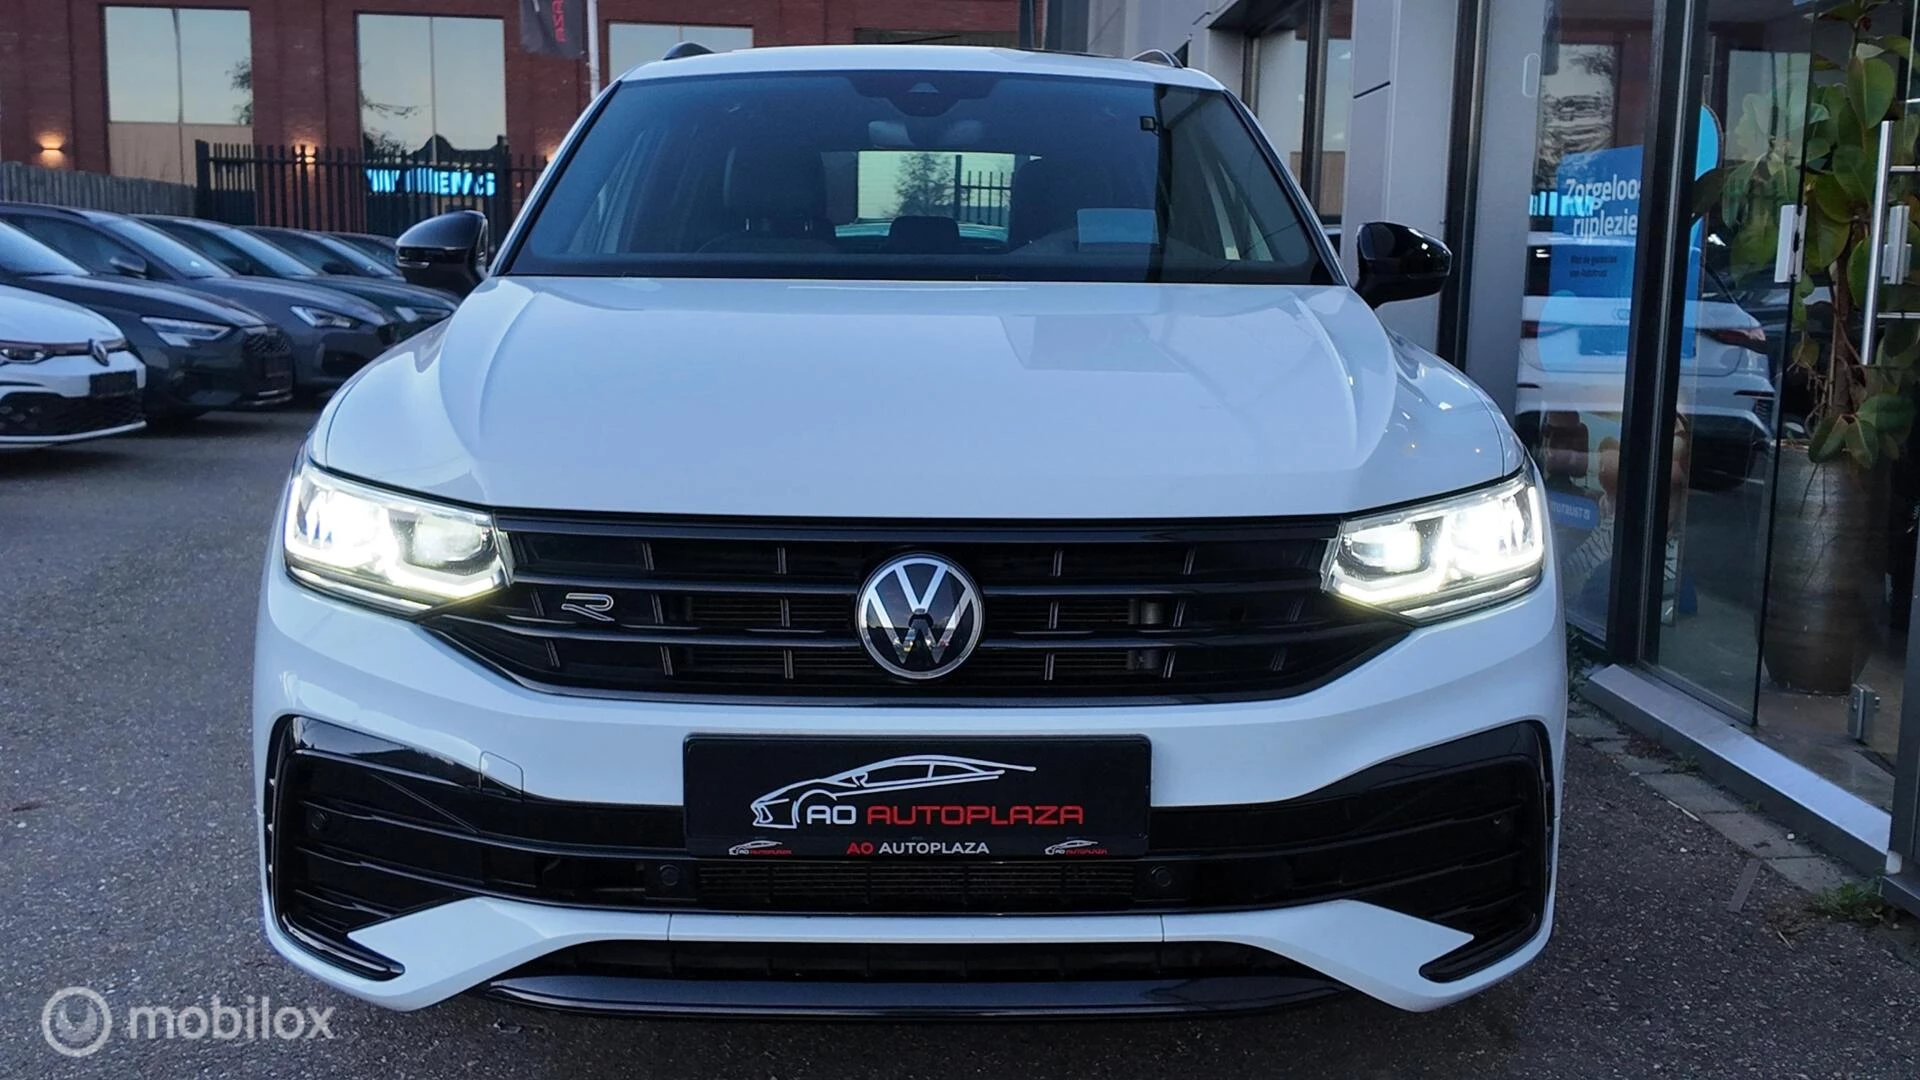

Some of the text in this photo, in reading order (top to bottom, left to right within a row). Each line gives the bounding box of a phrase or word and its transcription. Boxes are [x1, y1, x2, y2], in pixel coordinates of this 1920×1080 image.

[807, 805, 1084, 825] AO AUTOPLAZA
[847, 842, 989, 854] AO AUTOPLAZA
